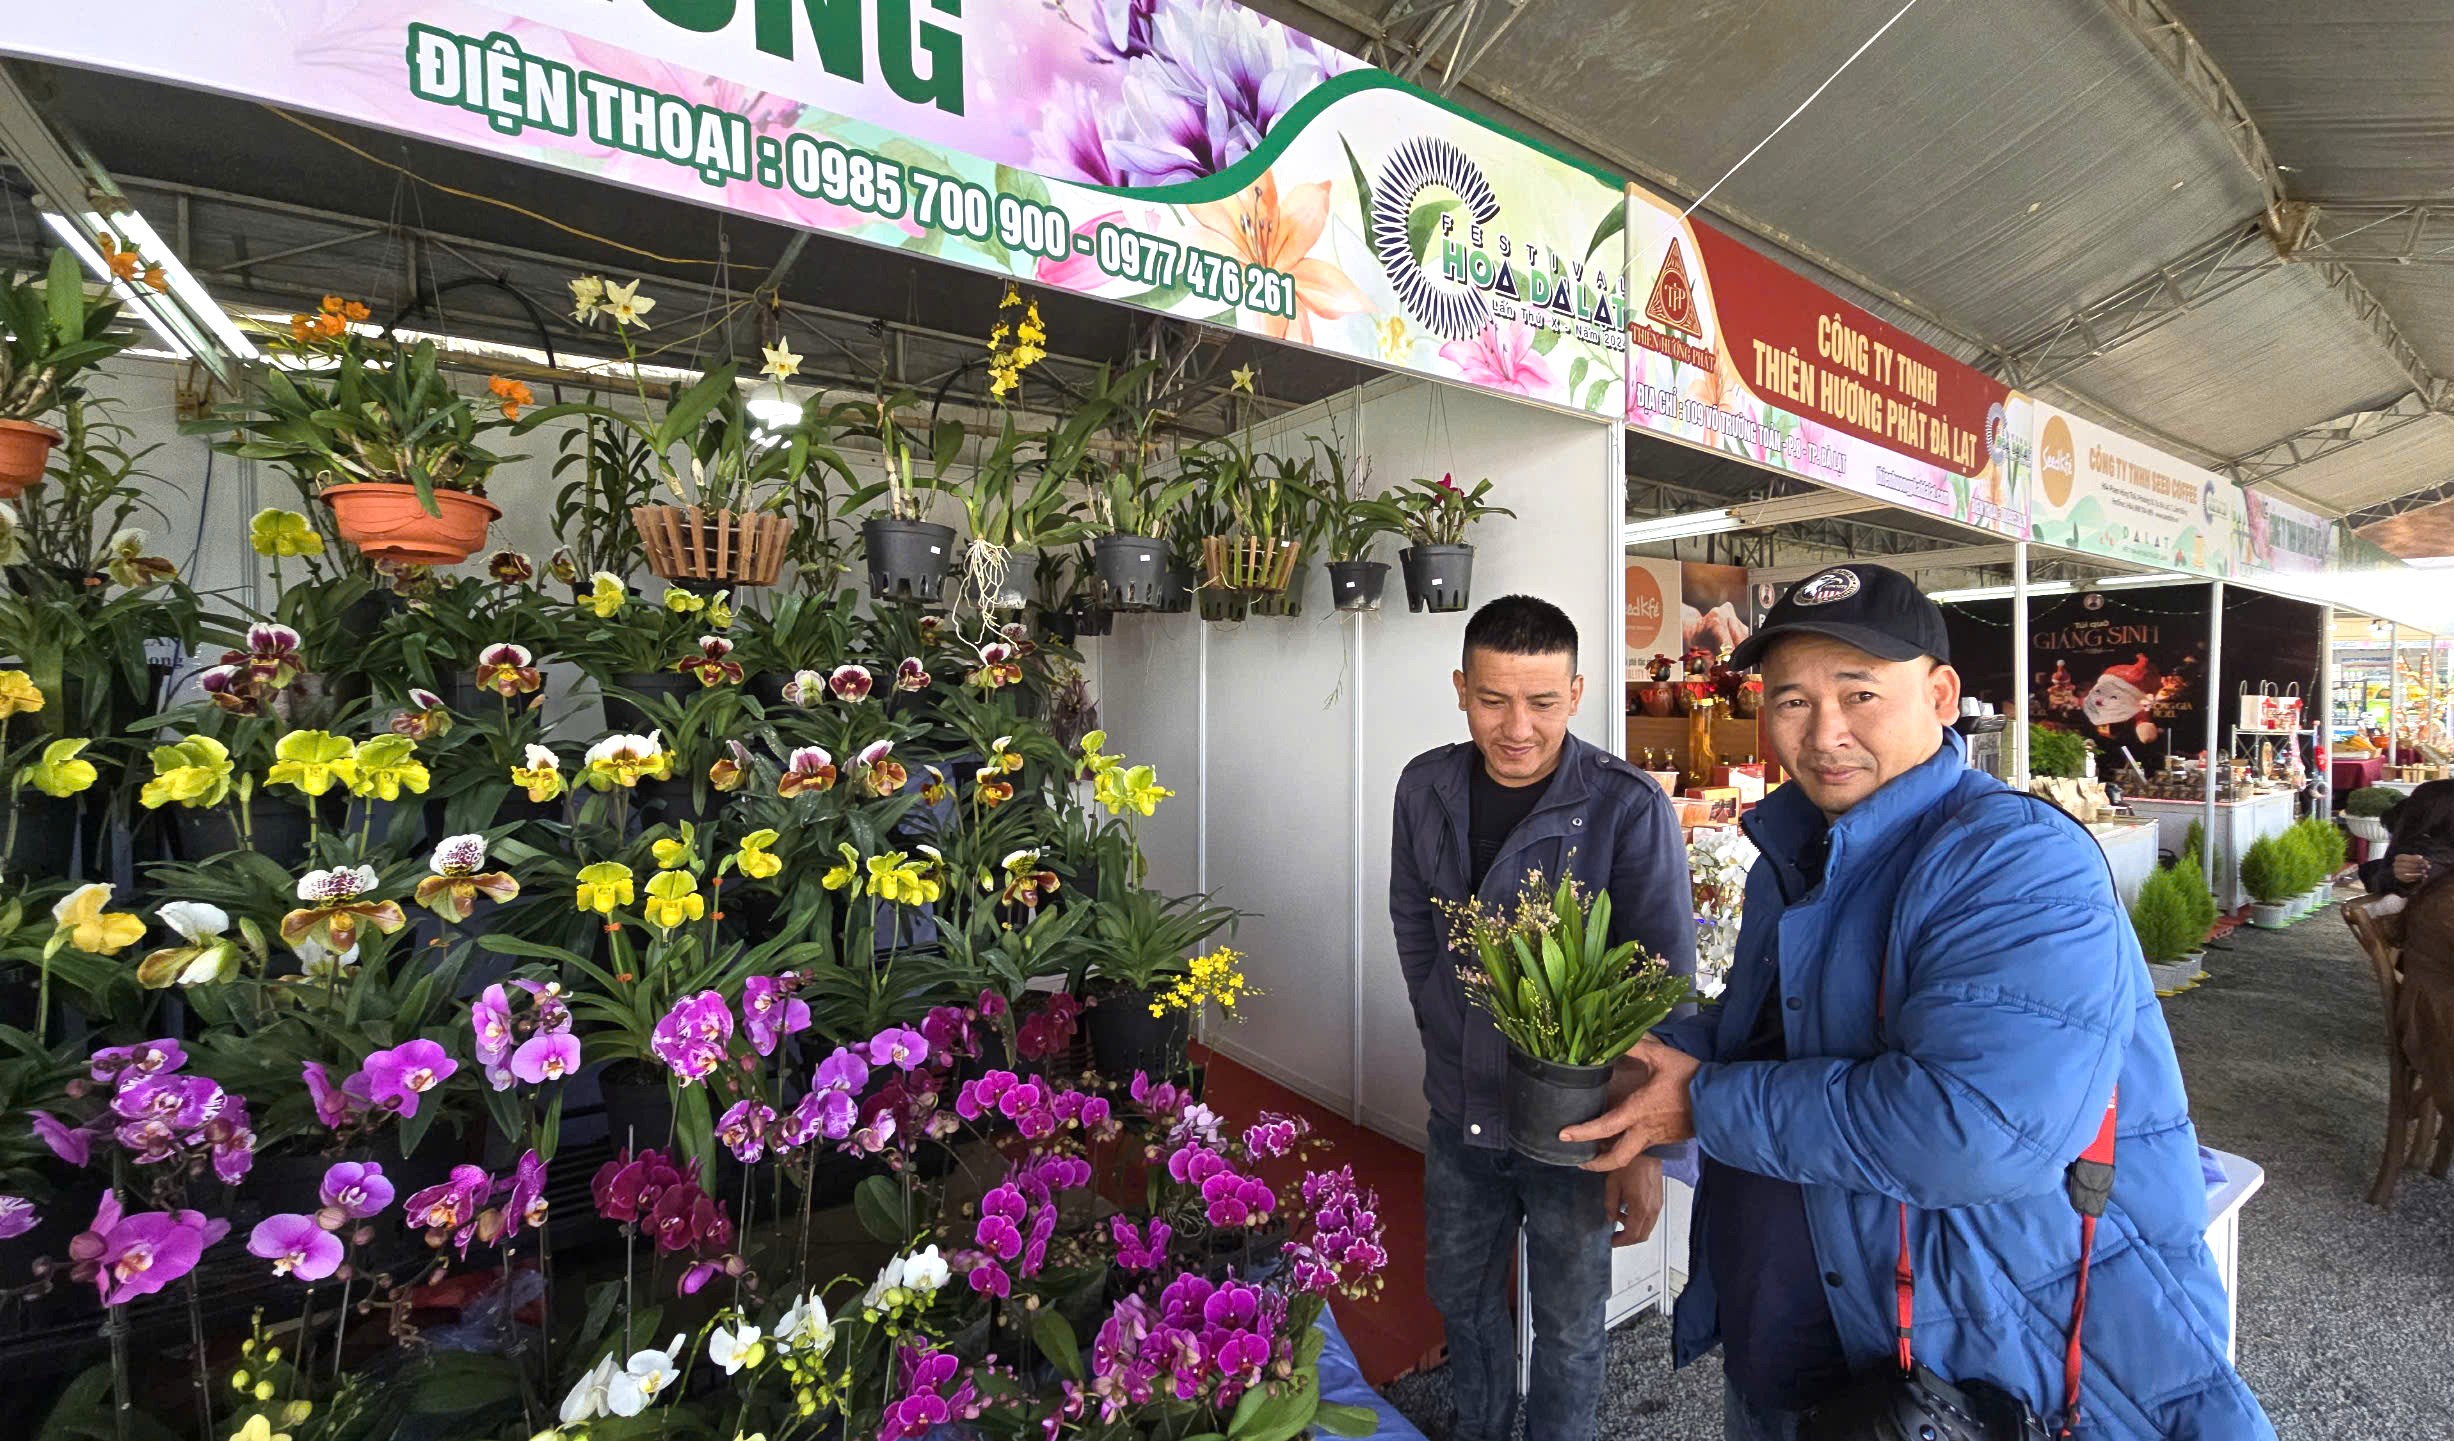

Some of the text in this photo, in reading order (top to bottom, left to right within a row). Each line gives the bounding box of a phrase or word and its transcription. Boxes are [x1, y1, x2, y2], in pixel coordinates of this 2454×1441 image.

[640, 0, 964, 117] NG
[409, 25, 573, 132] ĐIỆN
[582, 75, 749, 184] THOẠI
[789, 136, 905, 216] 0985
[910, 165, 990, 239] 700
[996, 196, 1068, 259] 900
[1097, 223, 1180, 288] 0977
[1185, 248, 1242, 305] 476
[1246, 264, 1296, 318] 261
[1442, 214, 1625, 293] FESTIVAL
[1629, 322, 1660, 350] THIÊN
[1692, 347, 1716, 372] PHÁT
[1817, 312, 1938, 407] CÔNG TY TNHH
[1636, 381, 1657, 416] ĐỊA
[1658, 386, 1678, 419] CHỈ
[1684, 398, 1705, 428] 109
[1705, 403, 1720, 433] VÕ
[1719, 410, 1758, 445] TRƯỜNG
[1820, 444, 1833, 471] ĐÀ
[1832, 450, 1848, 478] LẠT
[1752, 338, 1815, 408] THIÊN
[1820, 369, 1883, 435] HƯƠNG
[1886, 397, 1928, 450] PHÁT
[1929, 413, 1951, 460] ĐÀ
[1952, 426, 1978, 474] LẠT
[2089, 443, 2115, 478] CÔNG
[2116, 457, 2128, 482] TY
[2128, 462, 2151, 490] TNHH
[2151, 471, 2170, 497] SEED
[2171, 478, 2198, 505] COFFEE
[2033, 625, 2161, 650] GIÁNG SINH
